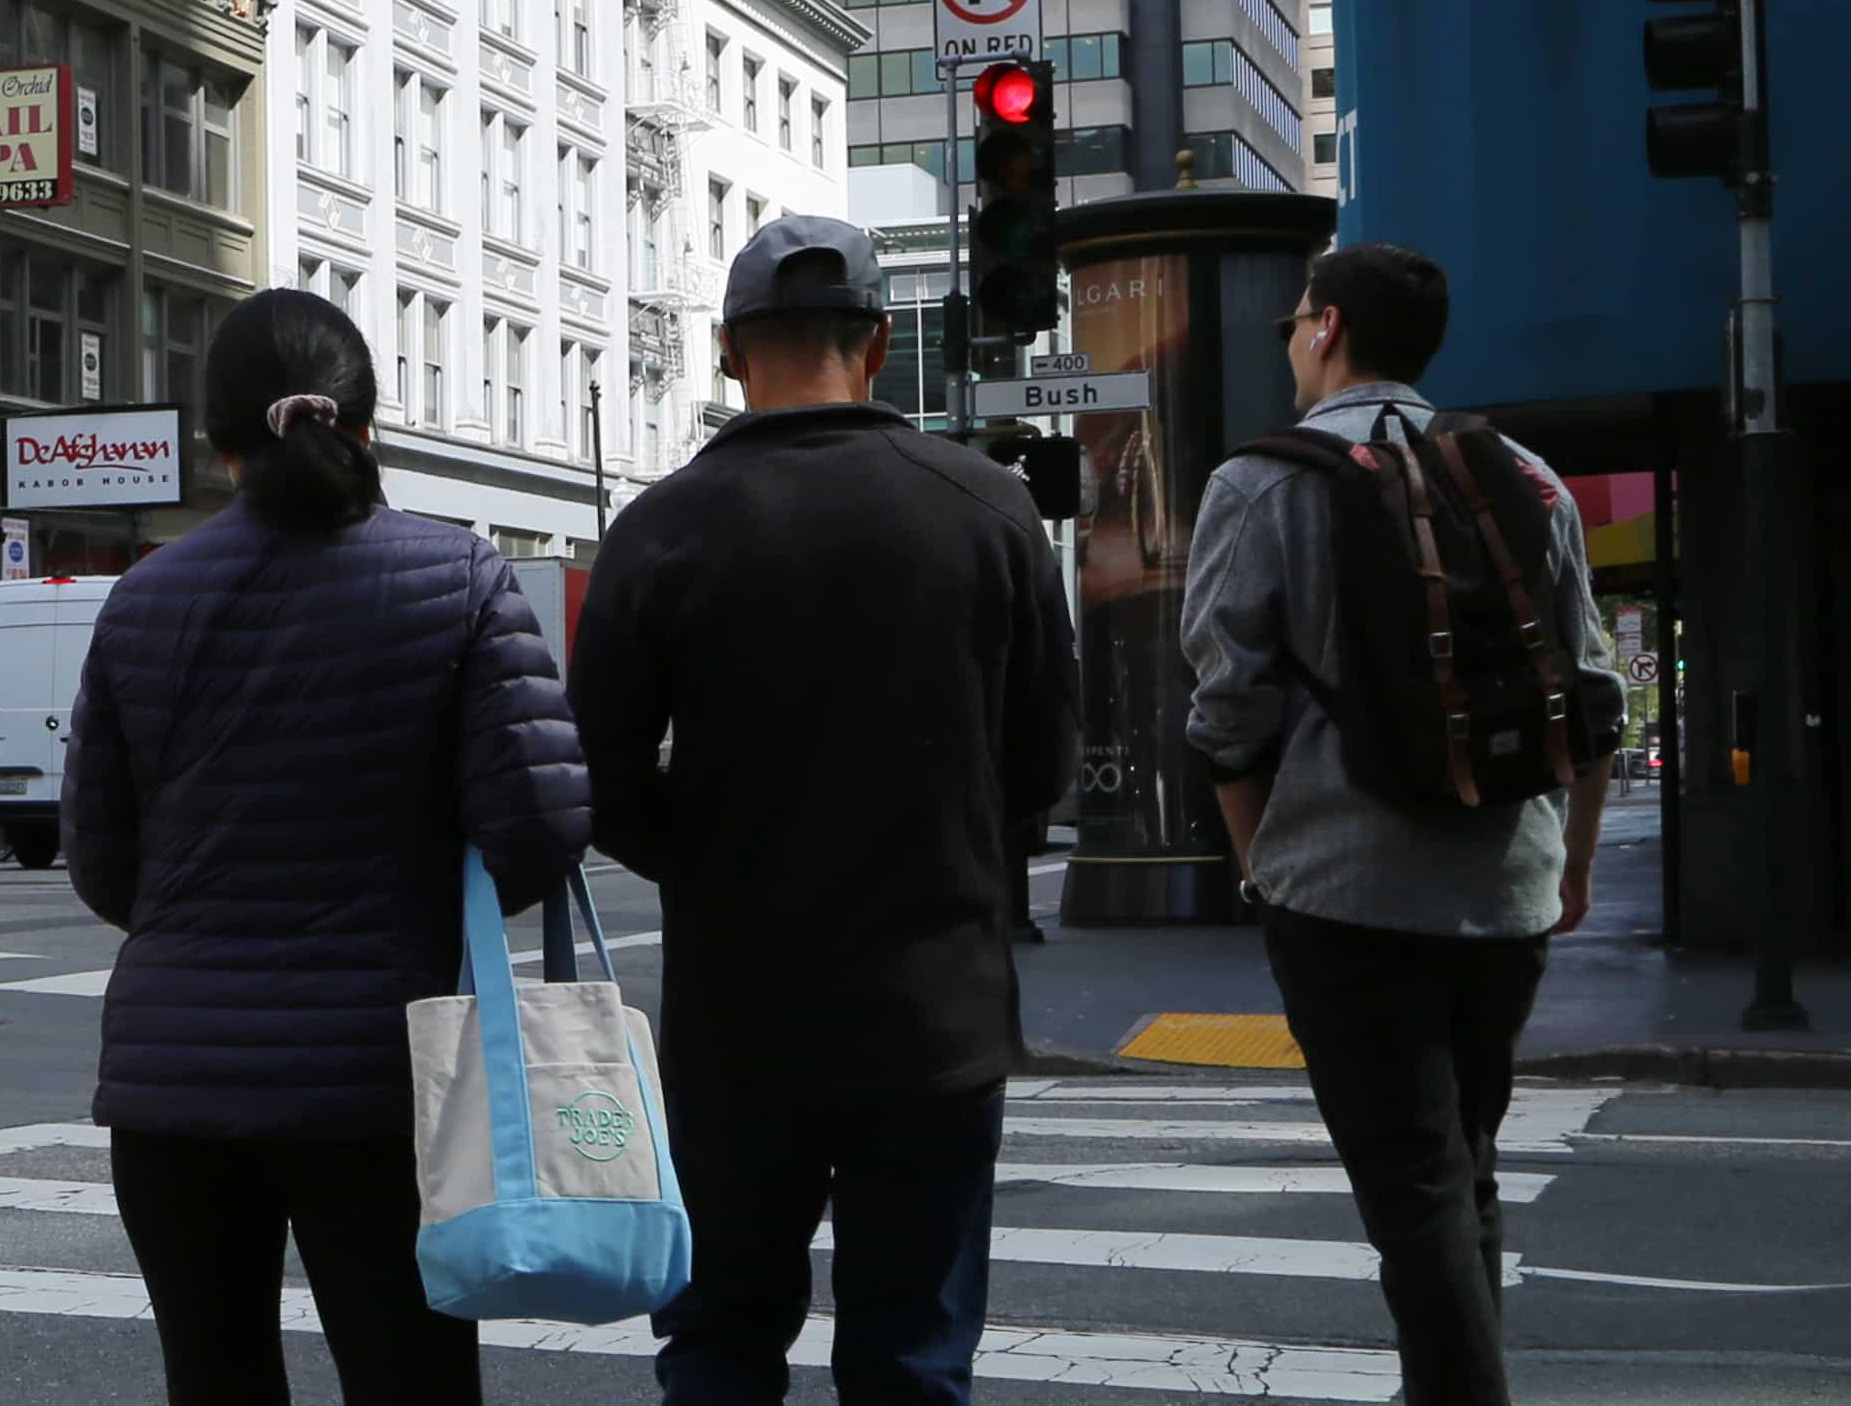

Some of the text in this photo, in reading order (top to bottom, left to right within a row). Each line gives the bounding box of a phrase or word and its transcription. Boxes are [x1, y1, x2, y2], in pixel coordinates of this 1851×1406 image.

[945, 33, 1033, 56] ON RED
[1, 73, 54, 98] Orchid
[1052, 355, 1085, 371] 400
[1024, 382, 1099, 408] Bush
[18, 474, 170, 490] KABOB HOUSE
[555, 1106, 635, 1131] TRADER
[568, 1127, 627, 1147] JOE'S
